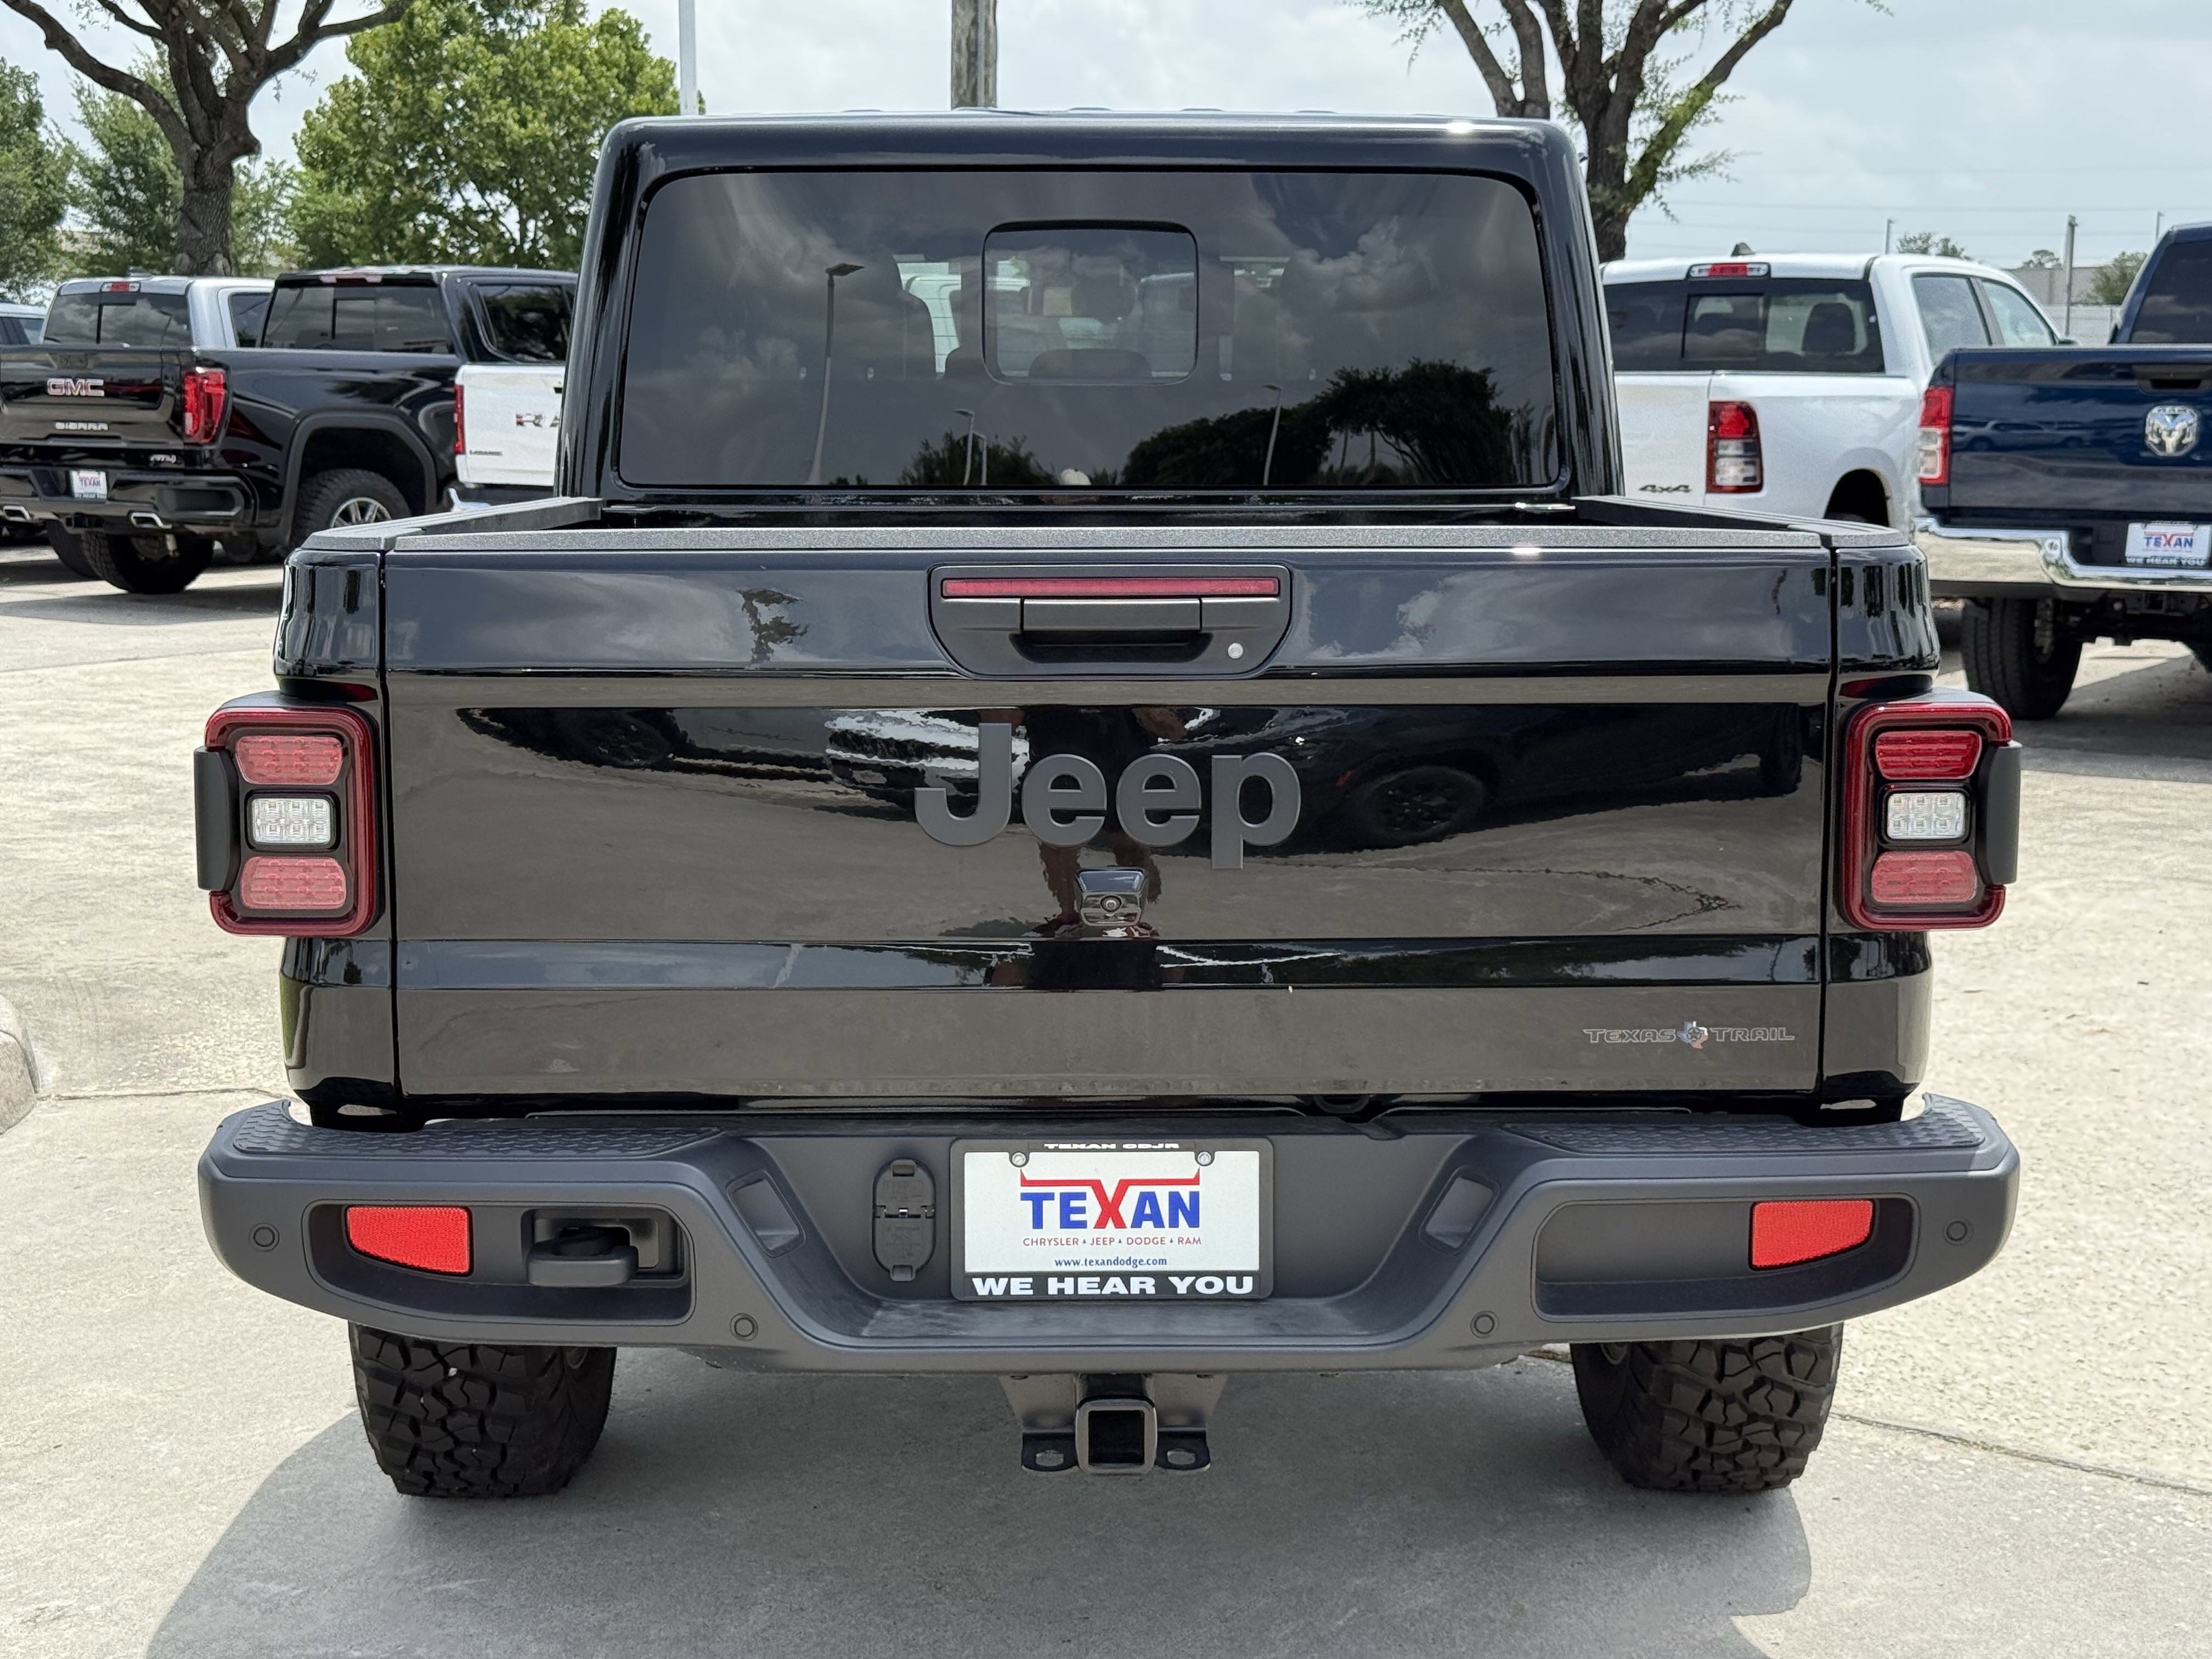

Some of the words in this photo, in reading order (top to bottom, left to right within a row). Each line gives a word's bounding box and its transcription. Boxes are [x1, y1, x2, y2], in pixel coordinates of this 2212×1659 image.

[47, 378, 105, 397] GMC
[2144, 533, 2193, 548] TEXAN
[914, 723, 1301, 870] Jeep
[1583, 1028, 1676, 1043] TEXAS
[1709, 1027, 1795, 1042] TRAIL
[1020, 1178, 1200, 1229] TEXAN
[1023, 1237, 1079, 1246] CHRYSLER
[1090, 1237, 1115, 1246] JEEP
[1126, 1237, 1166, 1245] DODGE
[1177, 1236, 1202, 1245] RAM
[1054, 1256, 1167, 1268] www.texandodge.com
[972, 1278, 1034, 1295] WE
[1047, 1277, 1156, 1295] HEAR
[1168, 1277, 1254, 1294] YOU
